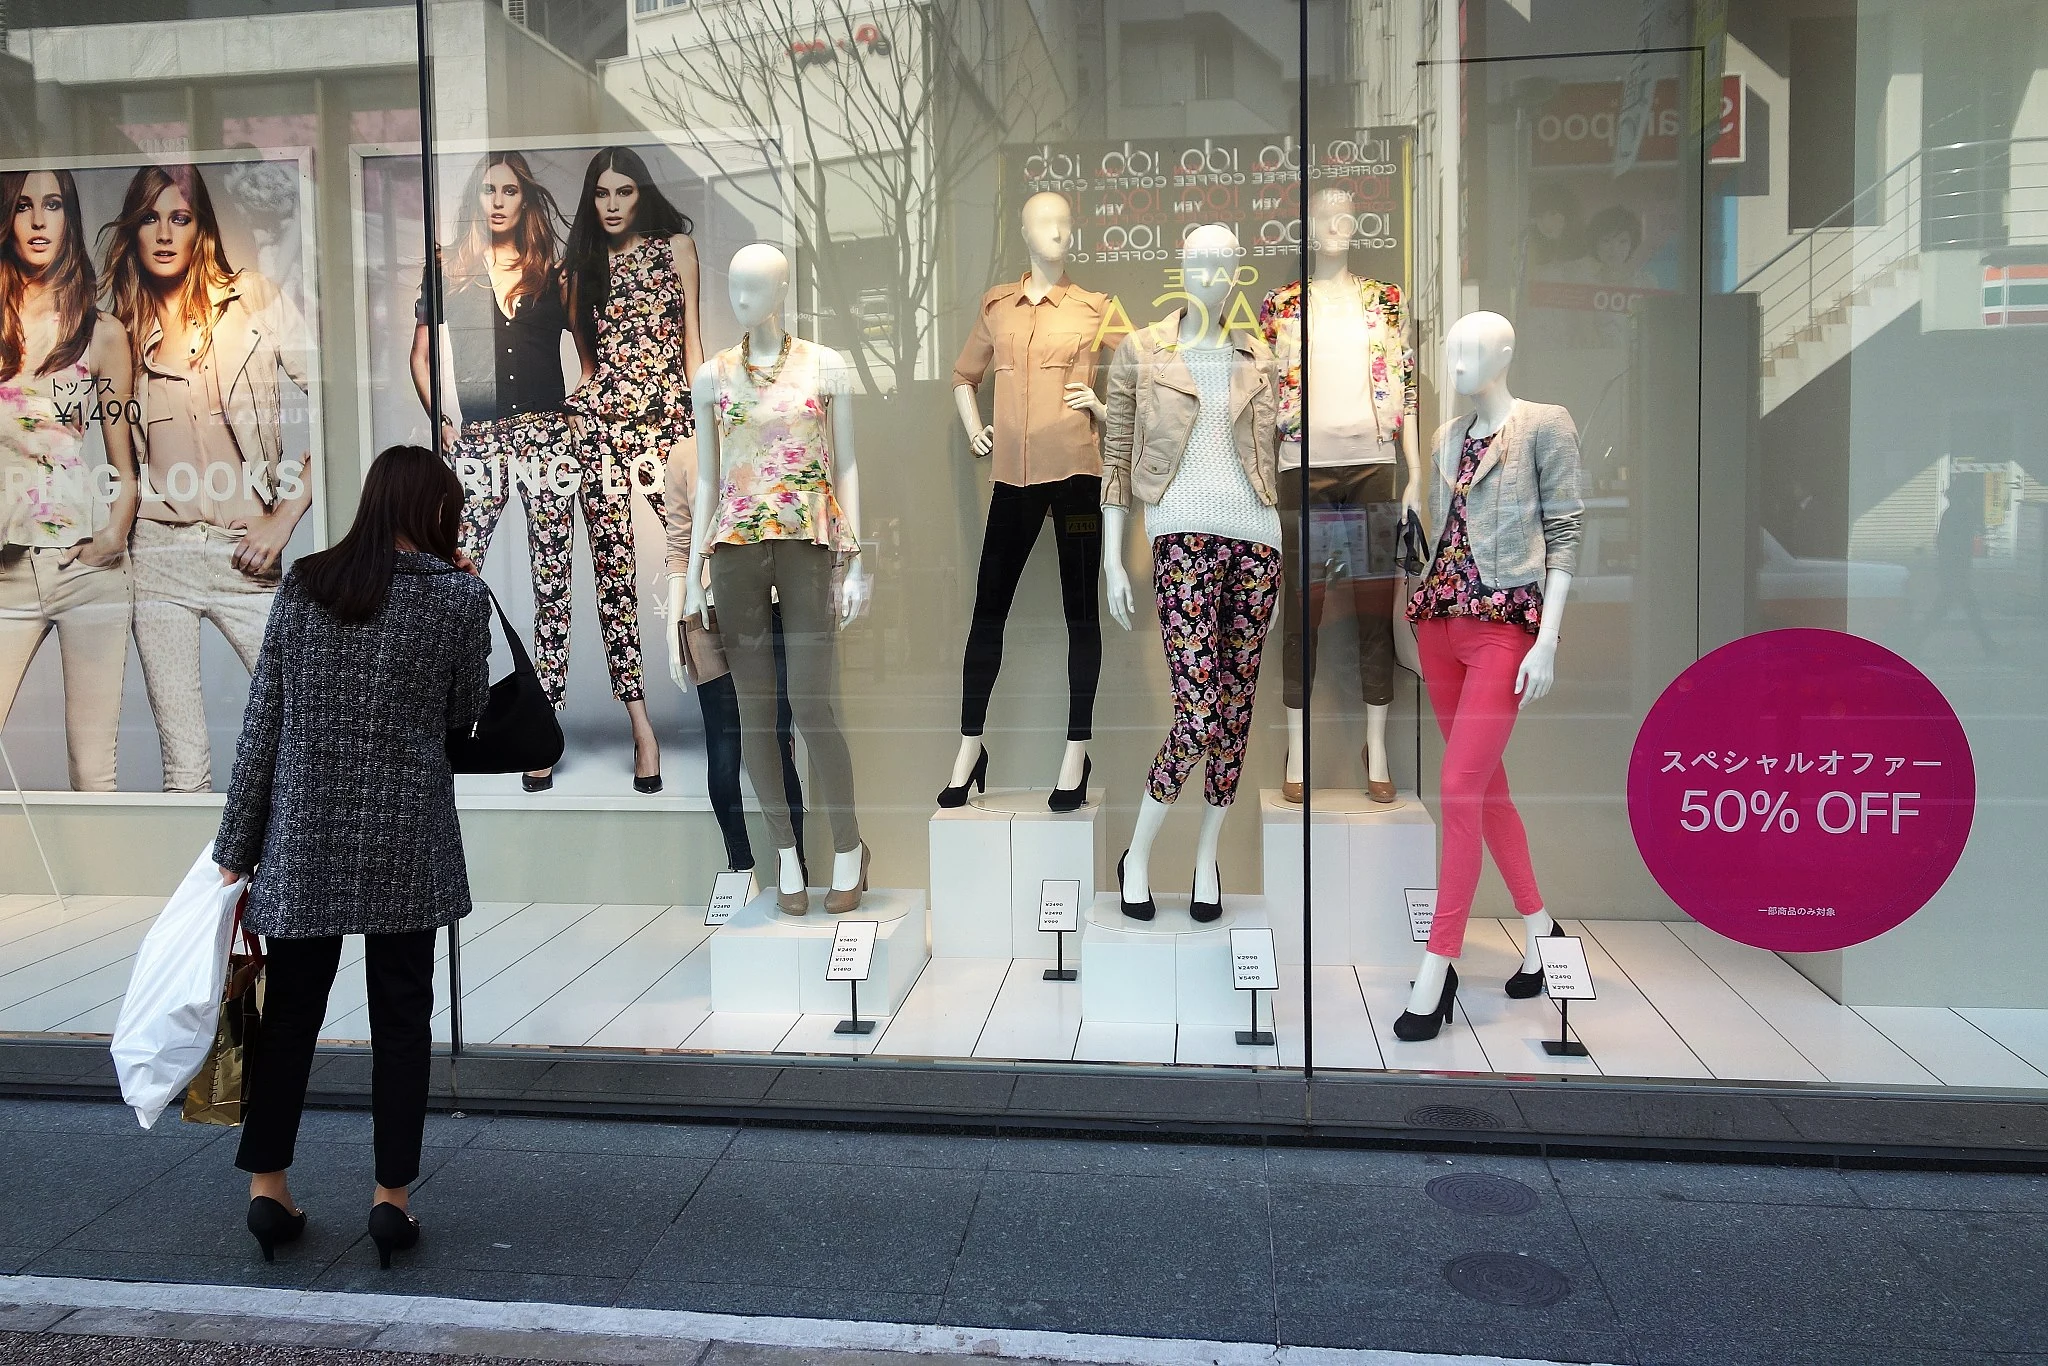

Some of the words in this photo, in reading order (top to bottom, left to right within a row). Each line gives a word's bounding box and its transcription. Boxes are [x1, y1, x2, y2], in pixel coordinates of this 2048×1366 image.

[52, 377, 116, 397] トップス
[54, 399, 142, 430] ¥1,490
[139, 459, 306, 503] LOOKS
[455, 454, 582, 498] RING
[1660, 749, 1942, 777] スペシャルオファー
[1679, 788, 1800, 834] 50%
[1815, 790, 1922, 835] OFF
[1757, 905, 1837, 918] 一部商品のみ対象
